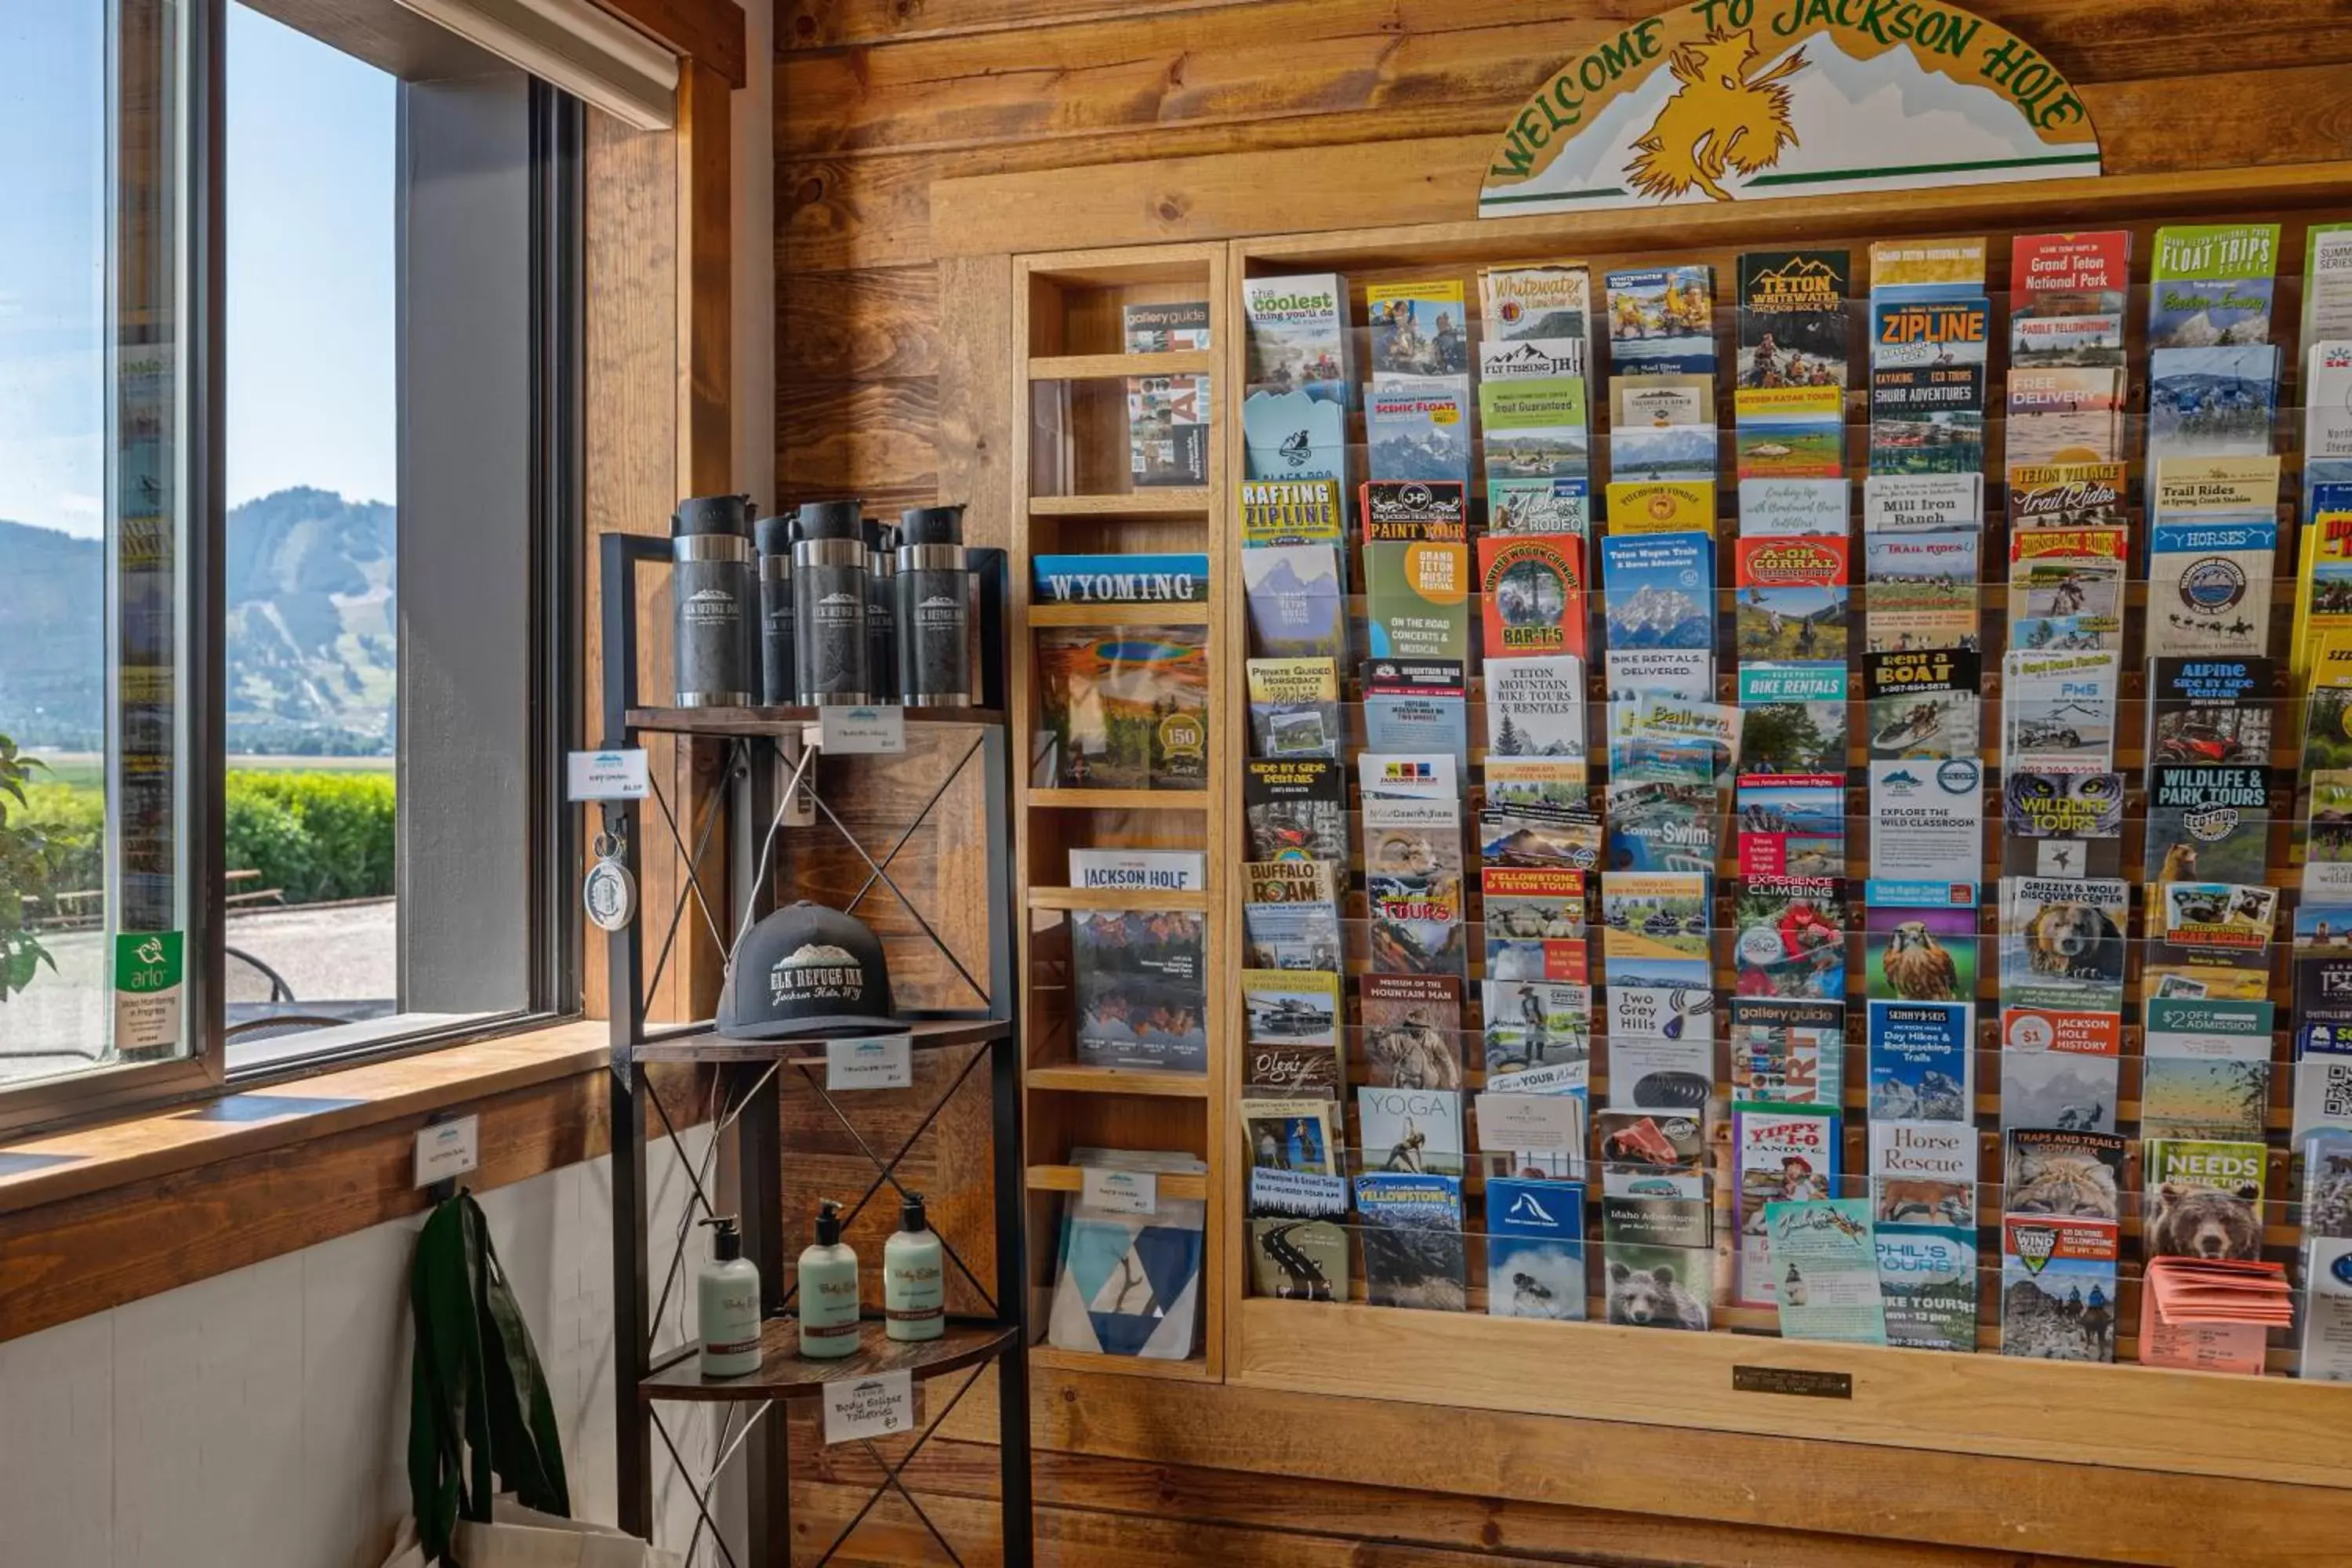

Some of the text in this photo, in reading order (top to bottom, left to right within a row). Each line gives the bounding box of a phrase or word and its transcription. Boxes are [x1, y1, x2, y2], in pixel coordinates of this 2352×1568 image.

[1491, 0, 2085, 185] WELCOME TO JACKSON HOLE
[2161, 237, 2270, 273] FLOAT TRIPS
[2031, 255, 2104, 272] Grand Teton
[1610, 274, 1664, 282] WHITEWATER
[1761, 276, 1831, 294] TETON
[2026, 273, 2108, 289] National Park
[1250, 287, 1276, 298] the
[1494, 277, 1583, 298] Whitewater
[1253, 292, 1333, 312] coolest
[1752, 292, 1839, 304] WHITEWATER
[1127, 310, 1206, 325] gallery guide
[1254, 307, 1334, 321] thing do
[1882, 311, 1985, 343] ZIPLINE
[1506, 362, 1550, 373] FISHING
[2013, 376, 2056, 390] FREE
[1773, 393, 1805, 402] KAYAK
[1806, 391, 1837, 401] TOURS
[1875, 386, 1972, 403] SHURR ADVENTURES
[2013, 390, 2096, 405] DELIVERY
[1374, 403, 1414, 415] SCENIC
[1493, 401, 1573, 413] Trout Guaranteed
[2019, 466, 2120, 485] TETON VILLAGE
[1242, 481, 1330, 506] RAFTING
[2013, 481, 2116, 514] Trail Rides
[2161, 485, 2234, 497] Trail Rides
[1884, 499, 1956, 512] Mill Iron
[1245, 505, 1331, 526] ZIPLINE
[1893, 514, 1945, 526] Ranch
[1370, 523, 1465, 539] PAINT YOUR
[1529, 518, 1582, 532] RODEO
[2187, 531, 2248, 547] HORSES
[1888, 543, 1920, 554] TRAIL
[1419, 551, 1454, 561] GRAND
[1419, 561, 1454, 572] TETON
[1754, 559, 1837, 569] CORRAL
[1419, 572, 1454, 583] MUSIC
[1049, 572, 1195, 601] WYOMING
[1391, 617, 1450, 629] ON THE ROAD
[1392, 630, 1439, 641] CONCERTS
[1399, 643, 1439, 654] MUSICAL
[1610, 655, 1639, 664] BIKE
[1252, 666, 1332, 677] PRIVATE GUIDED
[1511, 668, 1554, 678] TETON
[1875, 664, 1955, 684] BOAT
[1263, 676, 1322, 685] HORSEBACK
[1498, 680, 1568, 690] MOUNTAIN
[1749, 679, 1840, 695] BIKE RENTALS
[1497, 691, 1571, 702] BIKE TOURS
[2061, 683, 2099, 696] PMS
[1500, 703, 1569, 714] & RENTALS
[1167, 728, 1196, 745] 150
[2163, 769, 2263, 787] WILDLIFE &
[2158, 787, 2266, 806] PARK TOURS
[1881, 808, 1927, 817] EXPLORE
[2020, 797, 2109, 814] WILDLIFE
[2031, 815, 2096, 830] TOURS
[2183, 808, 2238, 826] ECOTOUR
[1622, 822, 1710, 844] Come Swim
[1083, 869, 1145, 888] JACKSON
[1250, 864, 1315, 879] BUFFALO
[1490, 873, 1577, 882] YELLOWSTONE
[1497, 881, 1581, 891] TETON TOURS
[1748, 876, 1833, 886] EXPERIENCE
[2024, 881, 2122, 894] GRIZZLY WOLF
[1748, 886, 1834, 898] CLIMBING
[2020, 891, 2124, 904] DISCOVERY CENTER
[1383, 902, 1452, 921] TOURS
[130, 966, 164, 989] arlo
[771, 967, 863, 989] ELK REFUGE INN
[772, 989, 811, 1006] Jackson
[1370, 988, 1452, 1000] MOUNTAIN MAN
[1621, 992, 1653, 1004] Two
[1618, 1004, 1657, 1018] Grey
[1739, 1007, 1833, 1021] gallery guide
[1621, 1017, 1657, 1029] Hills
[2056, 1018, 2111, 1030] JACKSON
[2162, 1011, 2211, 1029] $2 OFF
[2187, 1021, 2257, 1031] ADMISSION
[1884, 1031, 1951, 1043] Day Hikes &
[2022, 1029, 2040, 1043] $1
[2057, 1030, 2089, 1040] HOLE
[1883, 1041, 1951, 1054] Backpacking
[2056, 1040, 2107, 1051] HISTORY
[1904, 1052, 1931, 1062] Trails
[1520, 1072, 1555, 1087] YOUR
[1368, 1094, 1448, 1116] YOGA
[1750, 1123, 1822, 1144] YIPPY
[1894, 1128, 1961, 1149] Horse
[2017, 1134, 2122, 1149] TRAPS AND TRAILS
[1746, 1145, 1805, 1153] CANDY
[2074, 1146, 2099, 1156] MIX
[1885, 1149, 1964, 1172] Rescue
[2167, 1155, 2259, 1175] NEEDS
[2165, 1174, 2257, 1189] PROTECTION
[1610, 1210, 1639, 1220] Idaho
[2016, 1236, 2055, 1247] WIND
